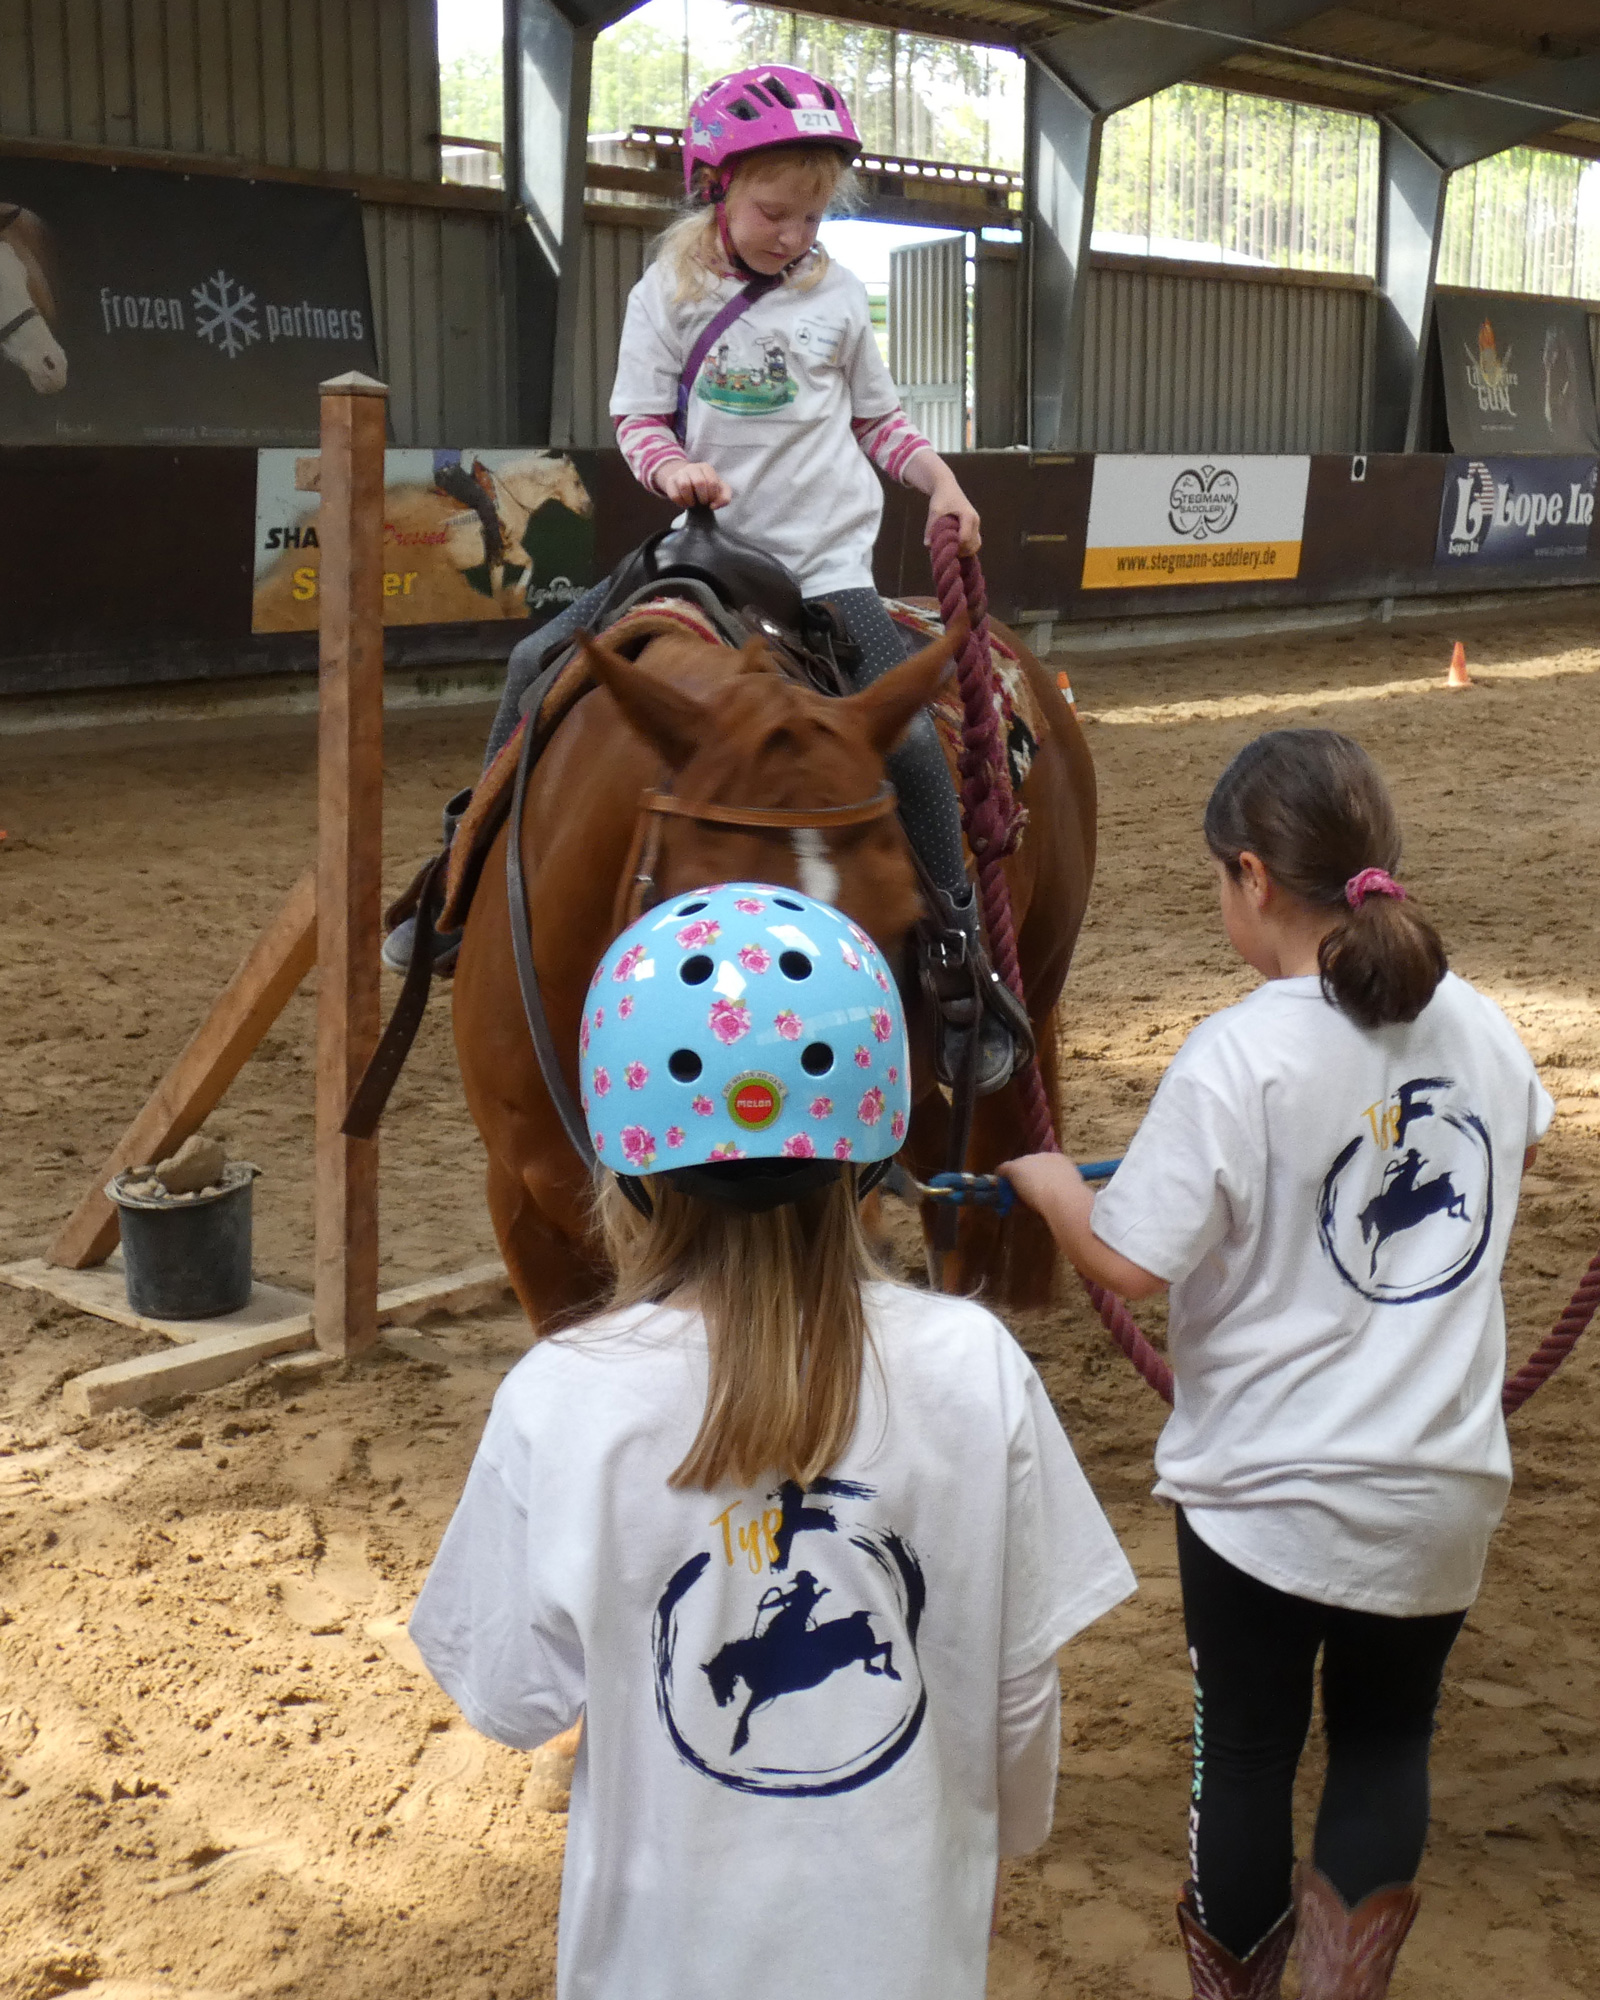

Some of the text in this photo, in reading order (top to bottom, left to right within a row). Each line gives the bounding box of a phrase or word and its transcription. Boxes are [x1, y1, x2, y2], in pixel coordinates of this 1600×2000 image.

[802, 113, 831, 126] 271
[100, 287, 363, 342] frozen partners
[1170, 489, 1236, 509] STEGMANN
[1180, 504, 1227, 515] SADDLERY
[1494, 484, 1563, 536] Lope
[265, 526, 320, 549] SHA
[1117, 547, 1277, 574] www.stegmann-saddlery.de
[710, 1500, 783, 1575] Typ
